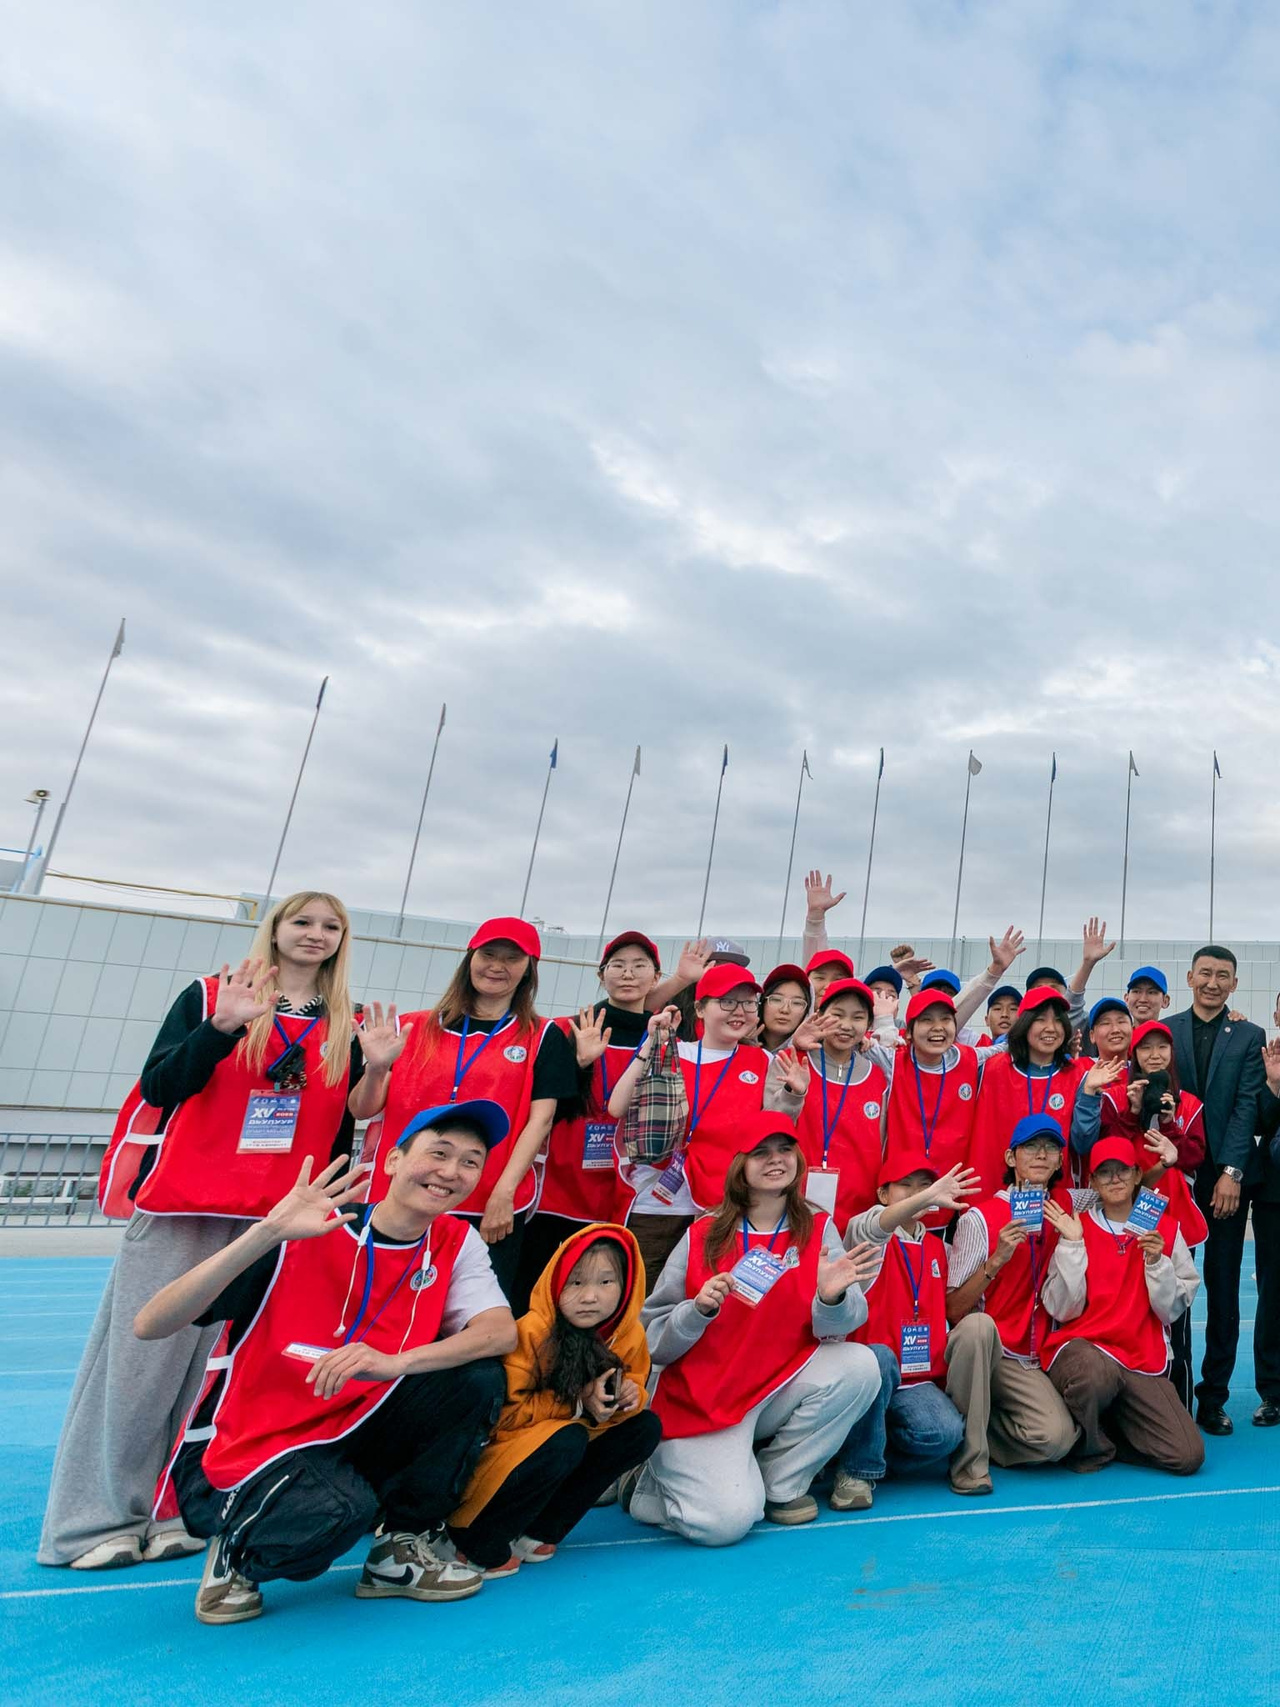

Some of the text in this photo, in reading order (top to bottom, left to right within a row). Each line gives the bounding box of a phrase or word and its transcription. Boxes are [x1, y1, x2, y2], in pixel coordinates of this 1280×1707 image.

[251, 1108, 276, 1118] XV
[588, 1133, 605, 1142] XV
[1014, 1201, 1028, 1210] XV
[1137, 1200, 1151, 1211] XV
[903, 1336, 916, 1346] XV
